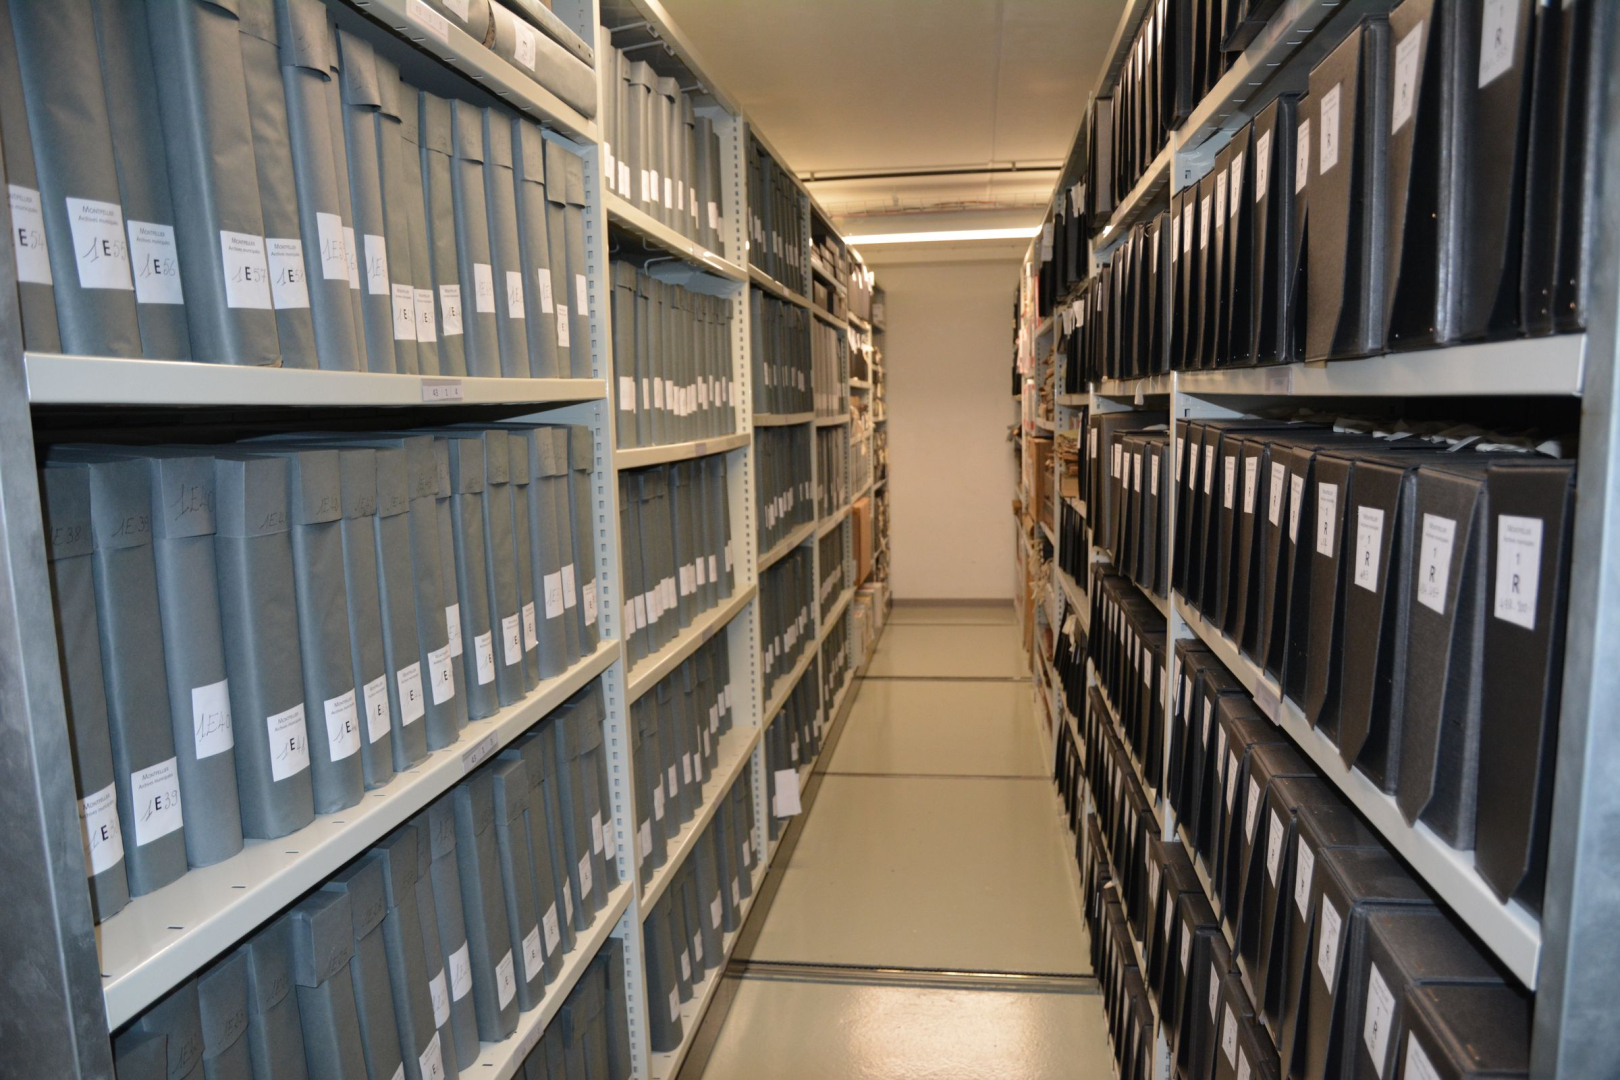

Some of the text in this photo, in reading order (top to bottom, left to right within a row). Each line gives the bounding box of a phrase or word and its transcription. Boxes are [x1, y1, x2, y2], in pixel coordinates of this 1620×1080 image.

[1494, 27, 1503, 49] R
[82, 205, 115, 217] MONTPELLIER
[139, 227, 166, 238] MONTPELLIER
[1364, 550, 1371, 567] R
[1433, 547, 1438, 558] 1
[1515, 552, 1521, 566] 1
[1428, 564, 1437, 584] R
[1511, 573, 1521, 594] R
[142, 767, 169, 781] MONTPELLIER
[138, 780, 154, 790] Archives
